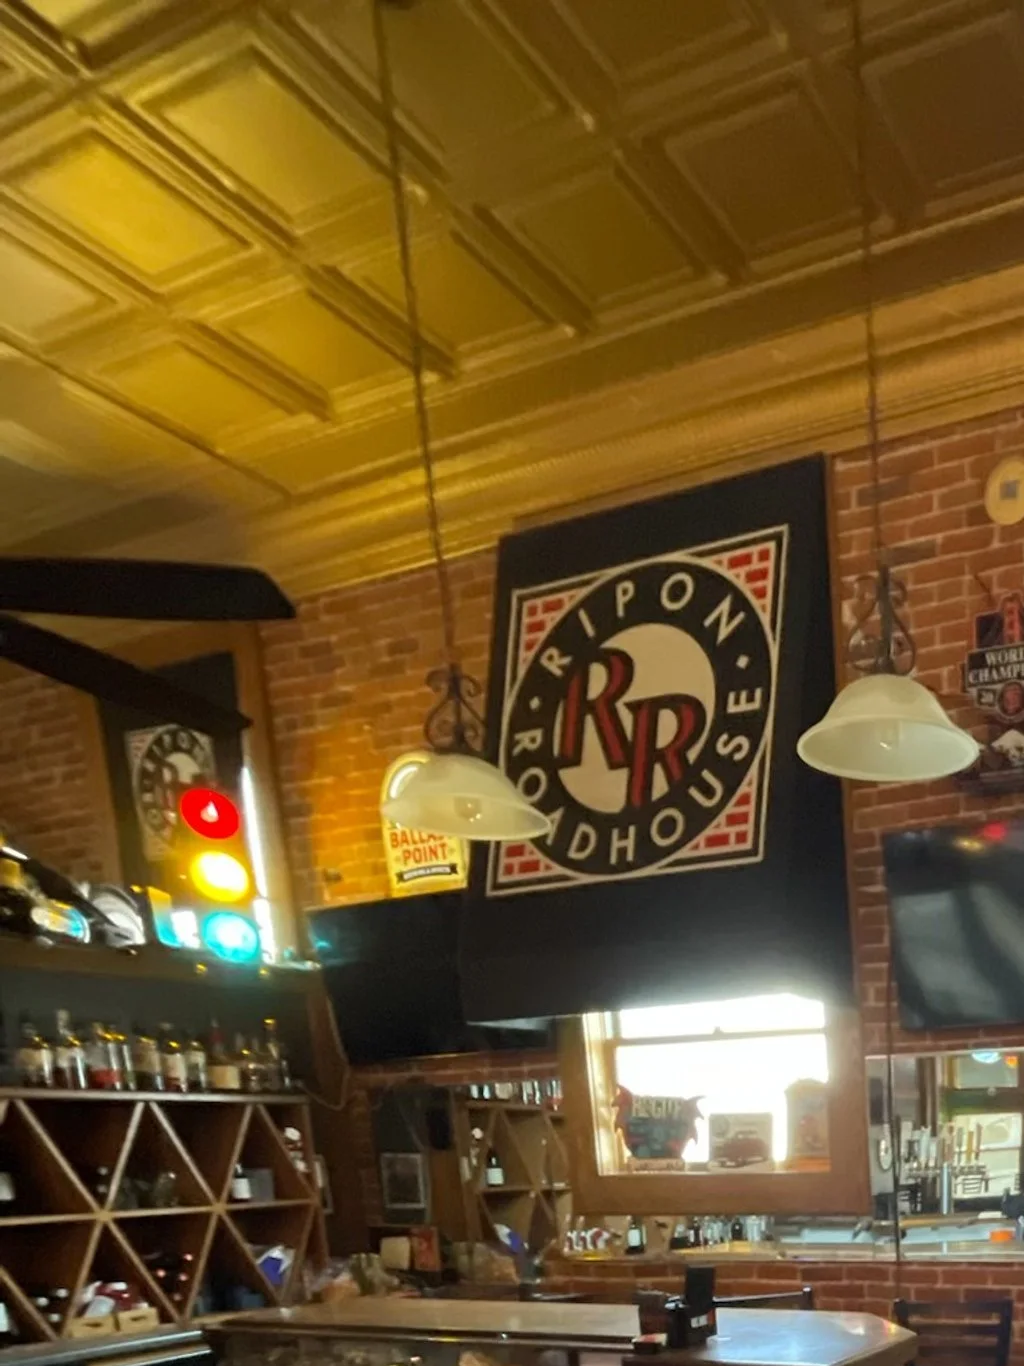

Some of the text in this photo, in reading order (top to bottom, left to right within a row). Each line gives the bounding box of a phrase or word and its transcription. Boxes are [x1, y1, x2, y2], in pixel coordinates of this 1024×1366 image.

[539, 571, 746, 677] RIPON
[513, 686, 764, 866] ROADHOUSE
[402, 842, 448, 867] POINT
